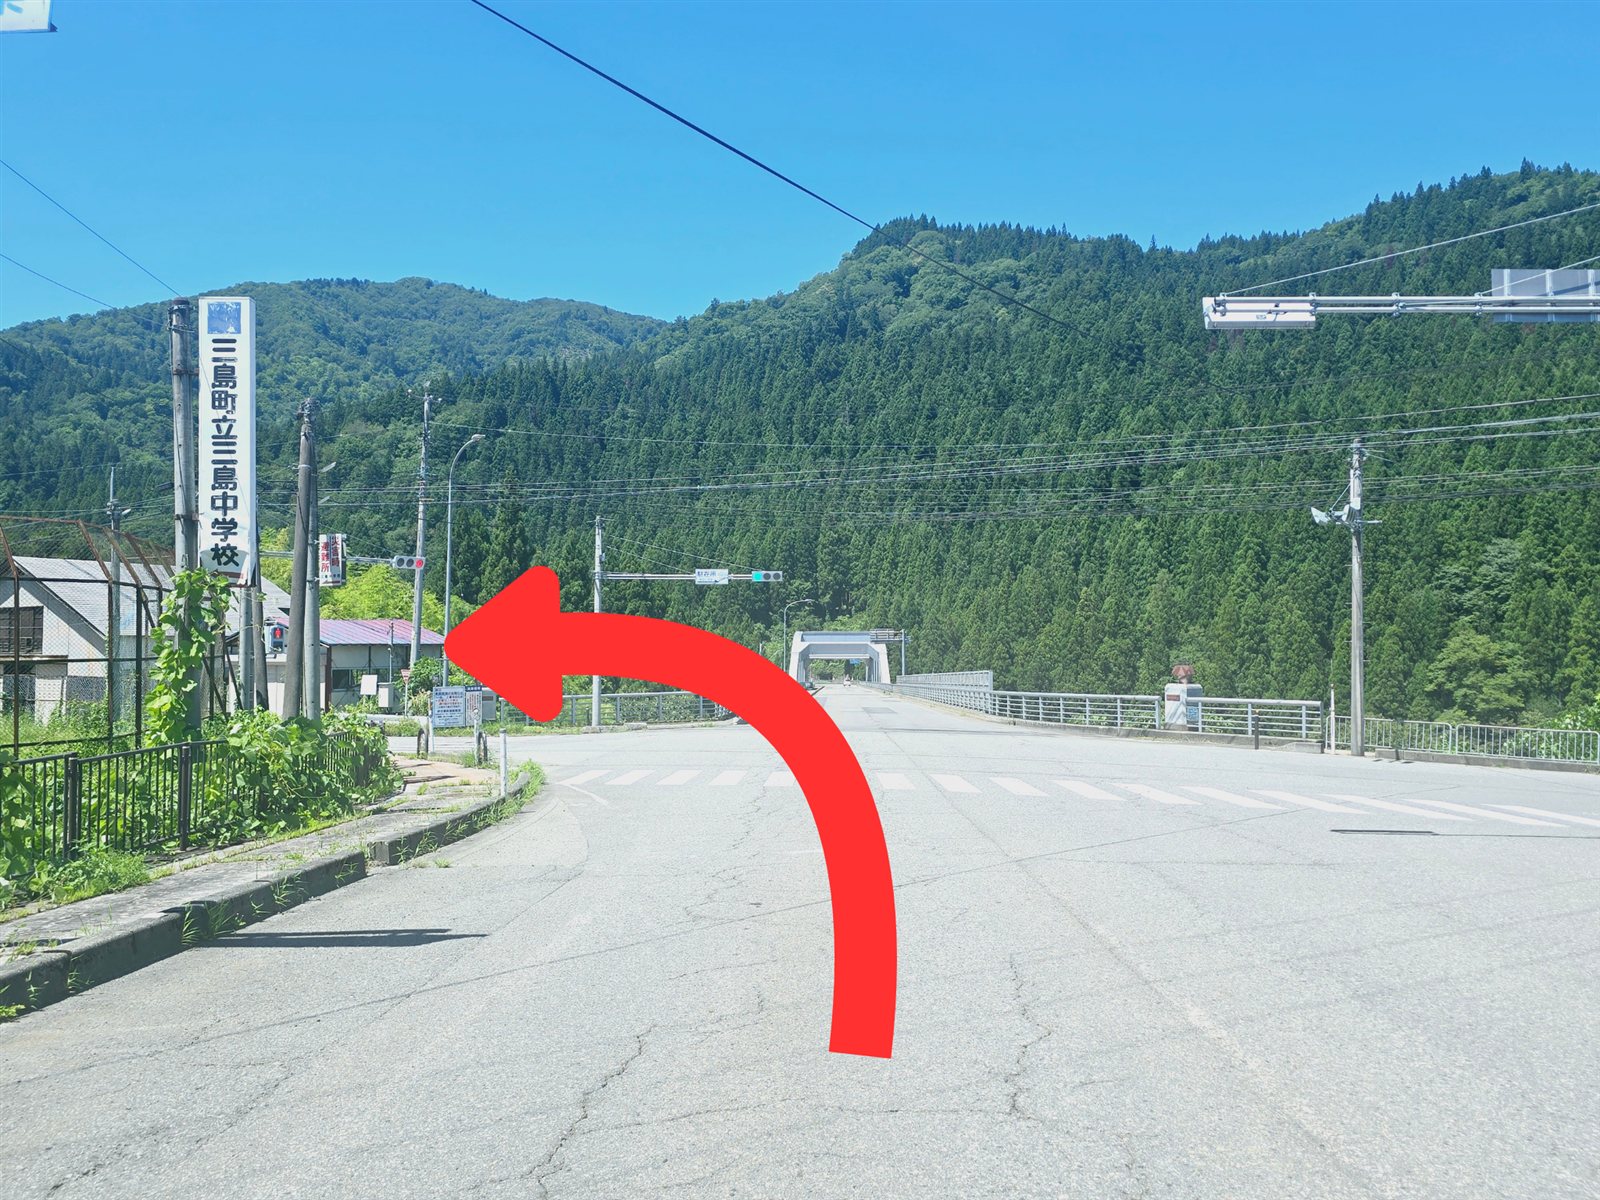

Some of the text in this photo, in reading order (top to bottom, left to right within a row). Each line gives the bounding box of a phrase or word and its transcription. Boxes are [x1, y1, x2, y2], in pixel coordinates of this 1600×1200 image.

[211, 338, 239, 567] 三島町立三島中学校
